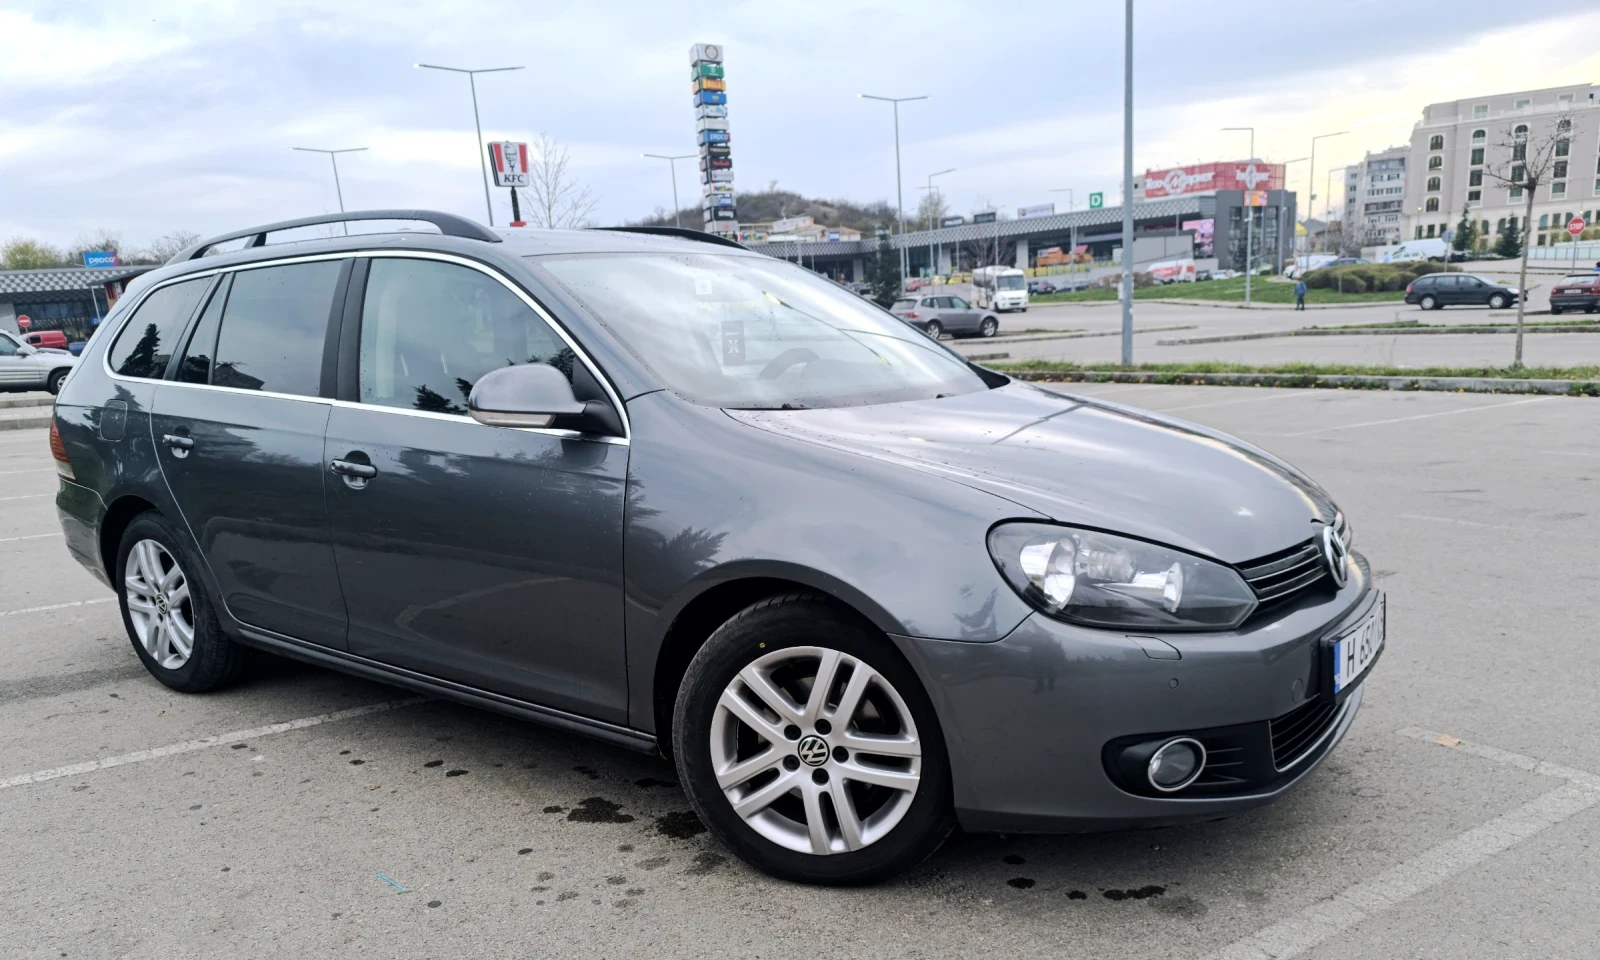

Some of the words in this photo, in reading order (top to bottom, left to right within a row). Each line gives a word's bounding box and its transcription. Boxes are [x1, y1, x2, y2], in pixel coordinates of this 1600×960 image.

[710, 133, 728, 141] pepco
[504, 174, 524, 183] KFC
[1569, 222, 1584, 231] STOP
[88, 256, 115, 265] pepco
